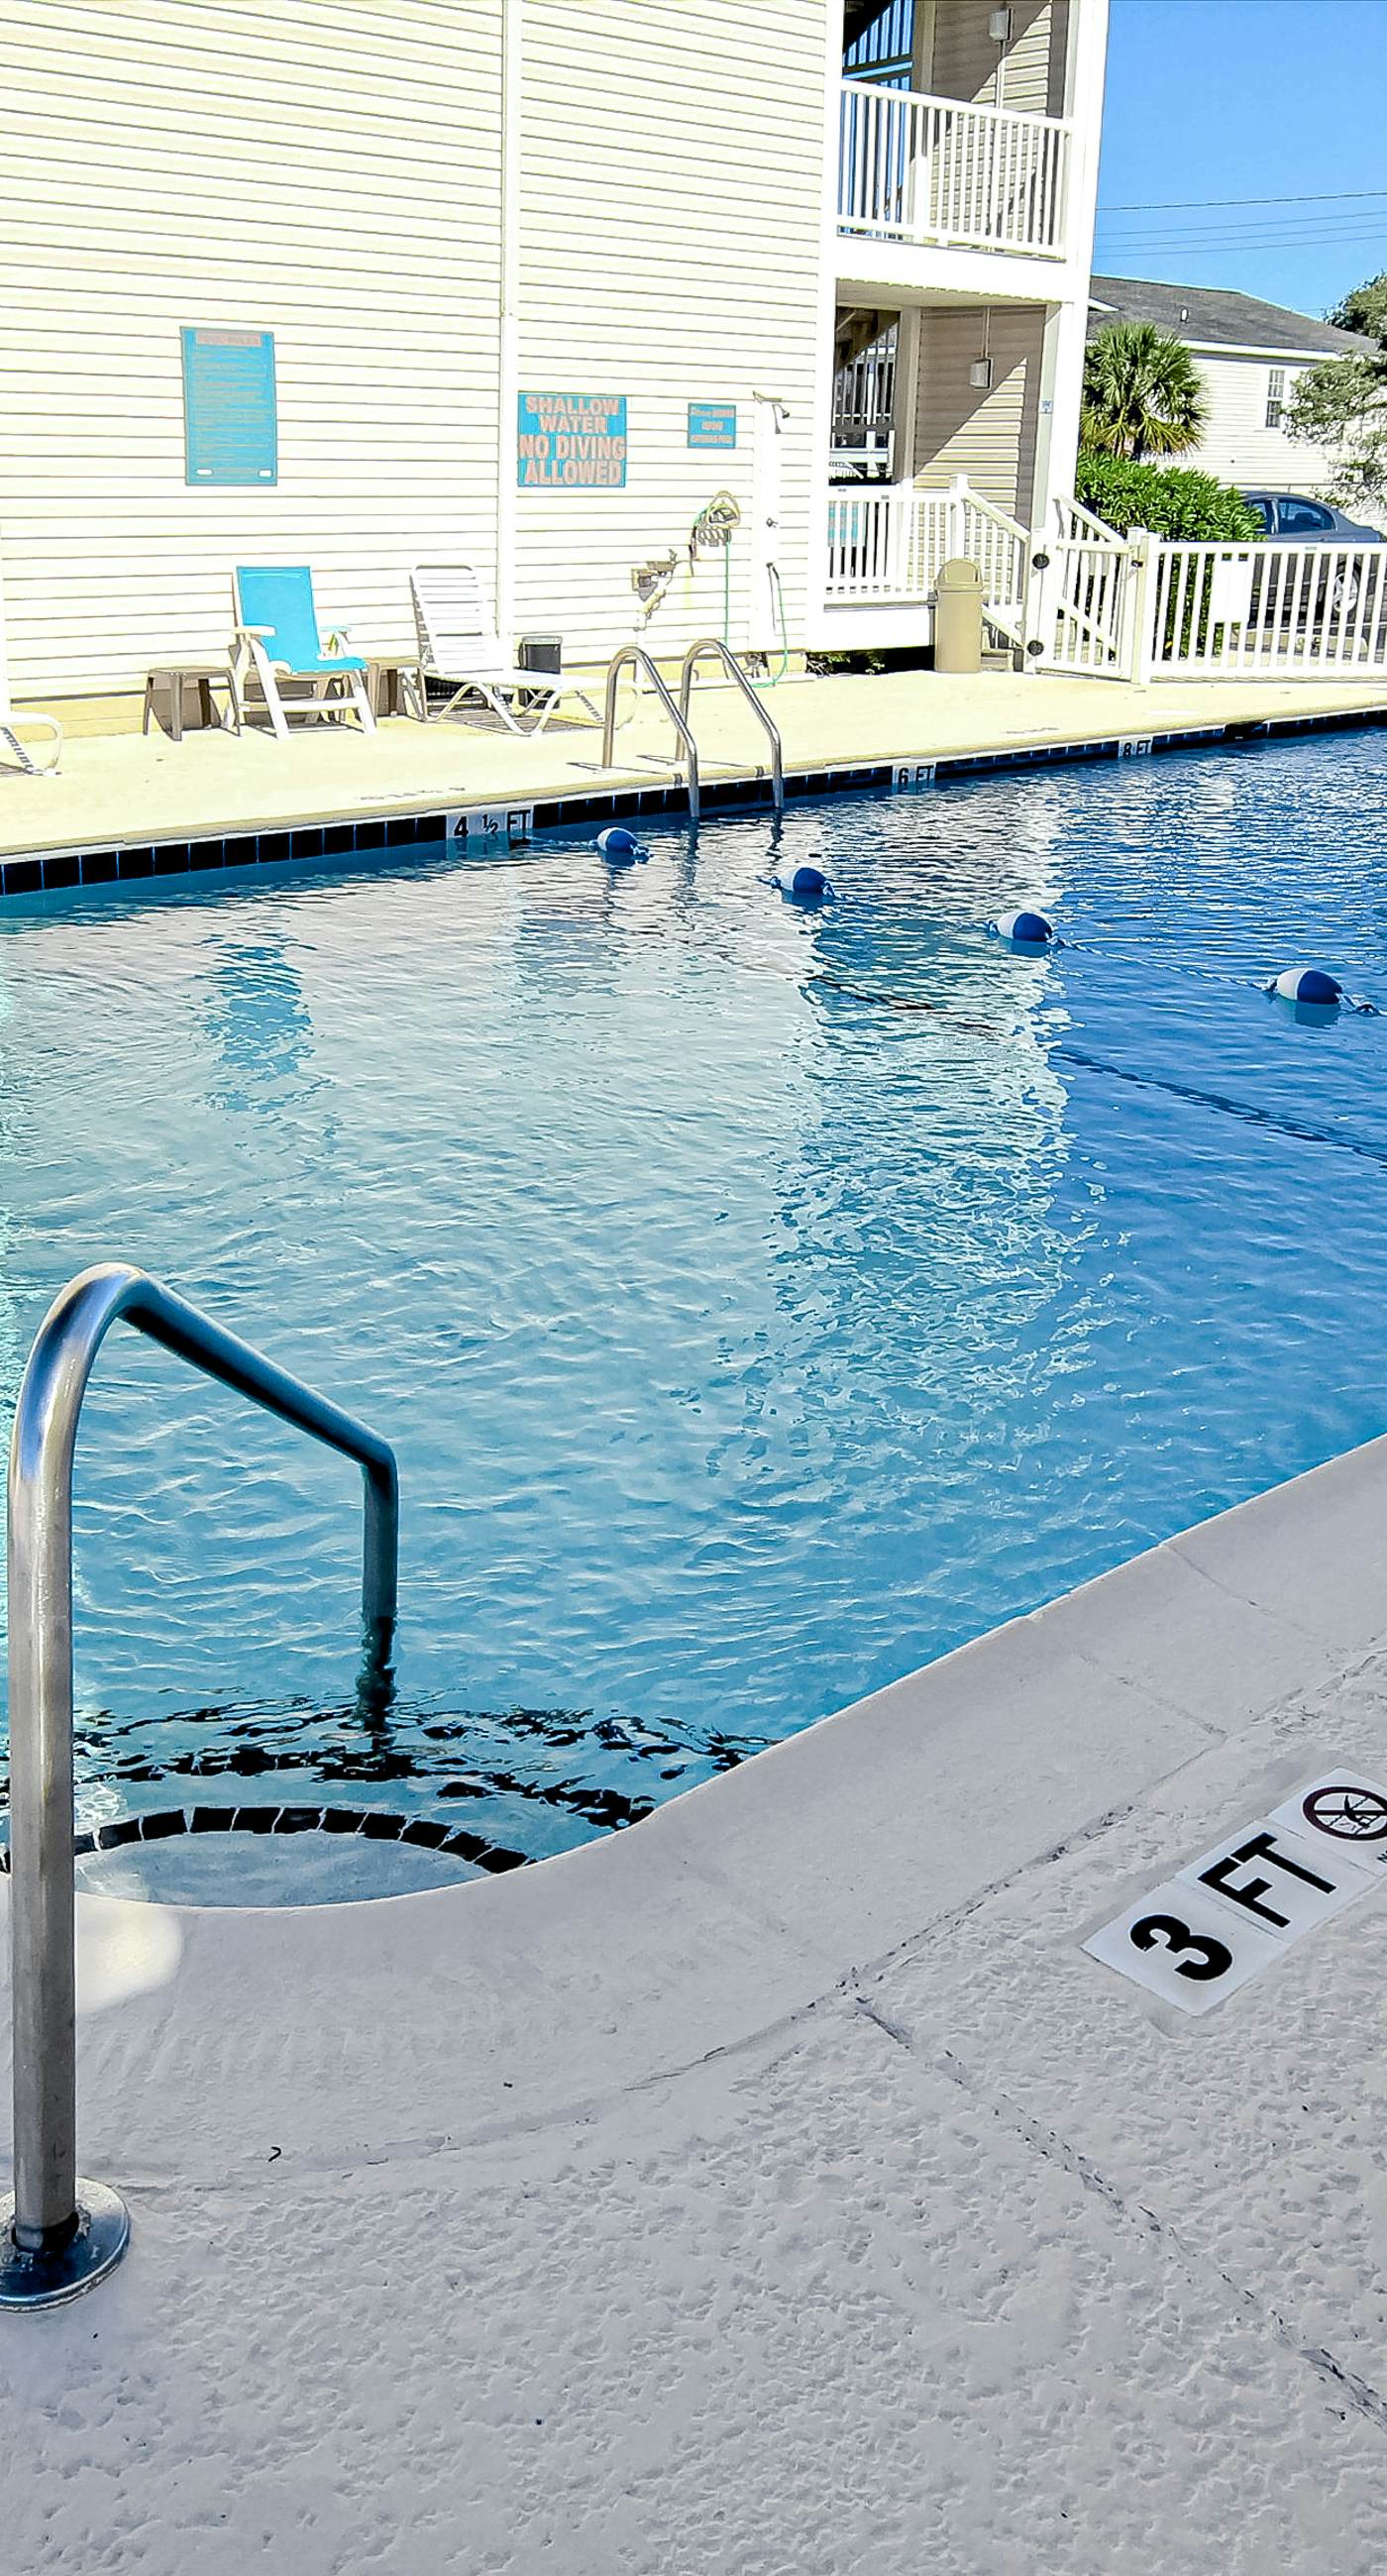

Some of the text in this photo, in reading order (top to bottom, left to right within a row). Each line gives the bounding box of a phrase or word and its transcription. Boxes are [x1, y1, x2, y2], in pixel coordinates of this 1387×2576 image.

[526, 395, 618, 414] SHALLOW
[539, 414, 607, 433] WATER
[519, 434, 626, 460] NO DIVING
[525, 459, 621, 484] ALLOWED
[898, 765, 934, 786] 6 FT
[453, 815, 470, 838] 4
[506, 808, 532, 839] FT
[1129, 1832, 1337, 1981] 3 FT
